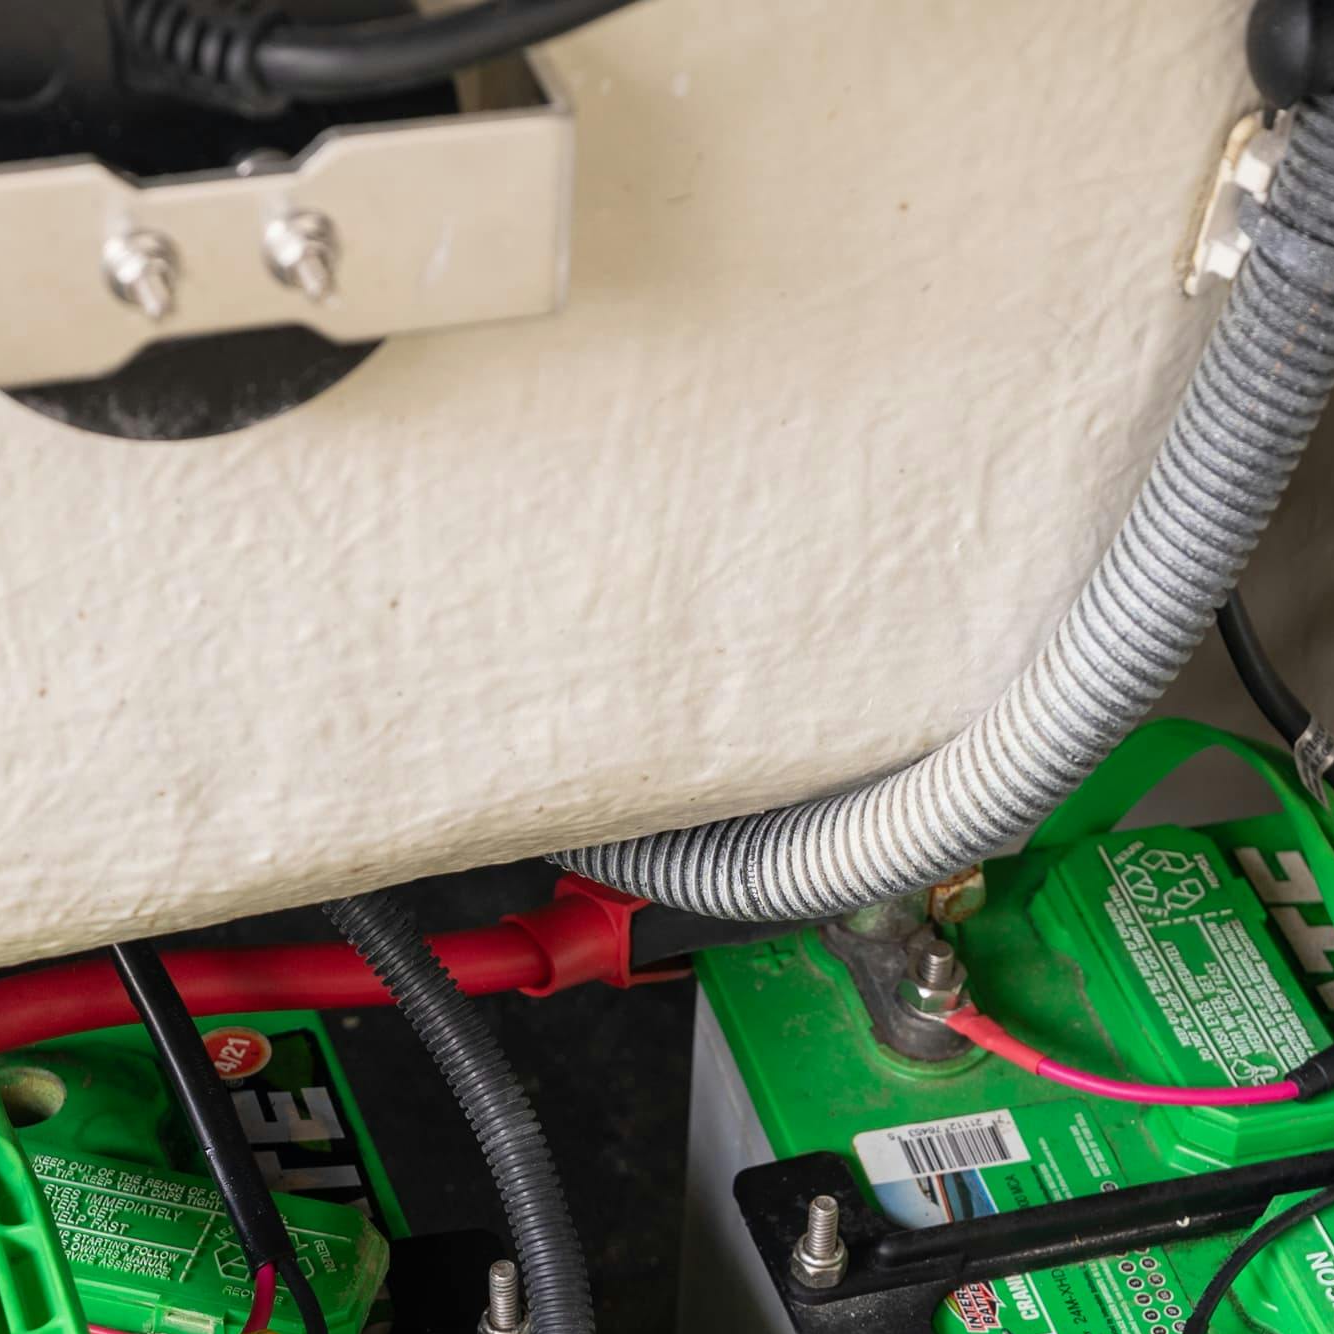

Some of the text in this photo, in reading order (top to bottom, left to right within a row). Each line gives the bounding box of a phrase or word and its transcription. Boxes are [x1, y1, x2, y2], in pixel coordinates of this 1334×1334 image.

[1204, 962, 1227, 986] FAST
[1217, 987, 1242, 1011] HELP
[1195, 1001, 1219, 1026] EYES
[210, 1036, 253, 1073] 4/21
[1210, 1027, 1237, 1058] FLUSH
[1228, 1030, 1251, 1056] WITH
[907, 1123, 941, 1138] 76453
[948, 1117, 982, 1131] 21112
[34, 1155, 65, 1167] KEEP
[68, 1161, 94, 1174] OUT
[97, 1167, 115, 1178] OF
[118, 1171, 142, 1184] THE
[145, 1177, 185, 1193] REACH
[187, 1186, 206, 1197] OF
[54, 1167, 74, 1180] TIP.
[80, 1174, 111, 1186] KEEP
[116, 1180, 147, 1194] VENT
[150, 1188, 182, 1202] CAPS
[186, 1194, 222, 1210] TIGHT
[43, 1183, 181, 1220] EYES IMMEDIATELY
[86, 1204, 117, 1220] GET
[90, 1217, 129, 1234] FAST
[70, 1241, 167, 1270] OWNERS MANUAL.
[72, 1232, 129, 1251] STARTING
[131, 1245, 179, 1261] FOLLOW
[98, 1257, 168, 1278] ASSISTANCE.
